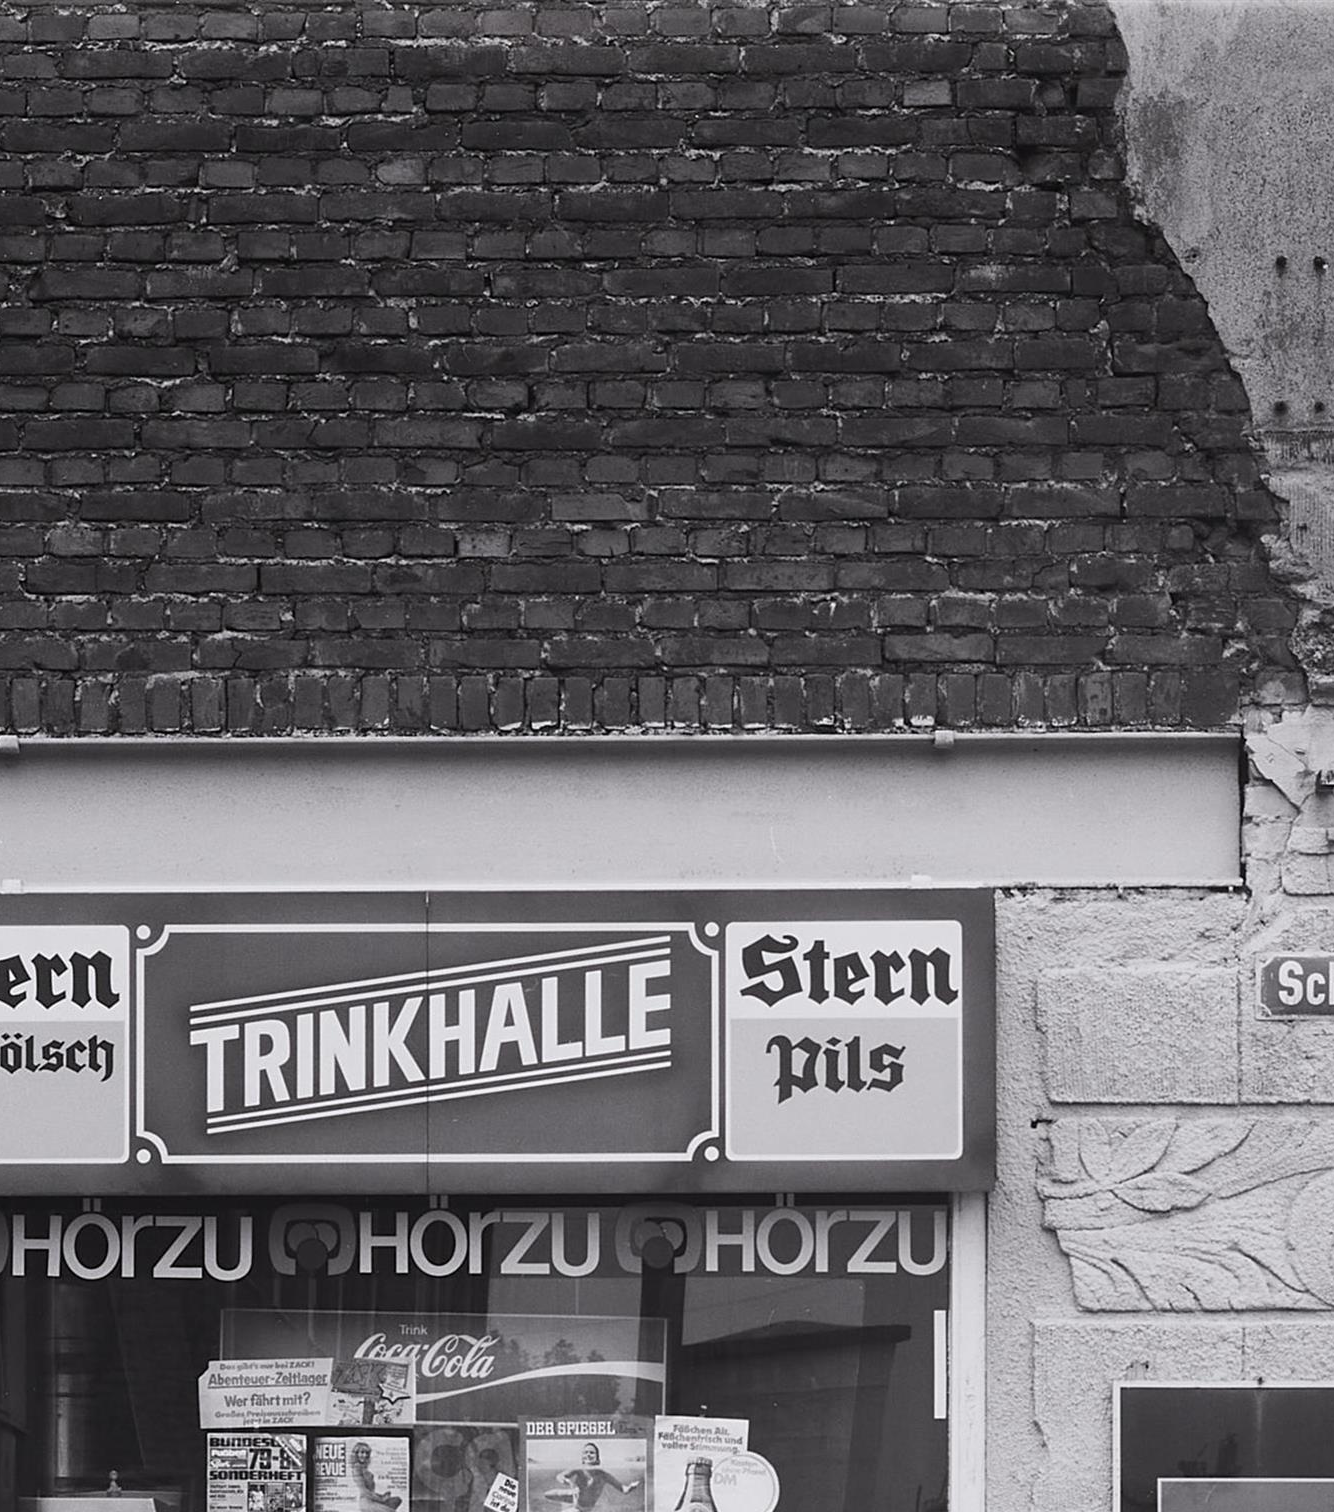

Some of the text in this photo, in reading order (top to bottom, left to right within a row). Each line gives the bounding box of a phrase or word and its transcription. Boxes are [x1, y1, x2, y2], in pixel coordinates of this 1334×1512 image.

[740, 934, 959, 1007] Stern
[190, 959, 671, 1113] TRINKHALLE
[766, 1034, 906, 1105] Pils
[399, 1324, 428, 1336] Trink
[353, 1333, 500, 1378] Coca-Cola
[208, 1371, 329, 1386] Abenteuer-Zeltlager
[224, 1391, 311, 1407] Wer fährt mit?
[526, 1421, 556, 1435] DER
[557, 1421, 616, 1435] SPIEGEL
[673, 1424, 713, 1435] Fäßchen
[658, 1431, 743, 1445] Fäßchenfrisch und
[315, 1443, 345, 1460] NEUE
[209, 1471, 302, 1480] SONDERHEFT
